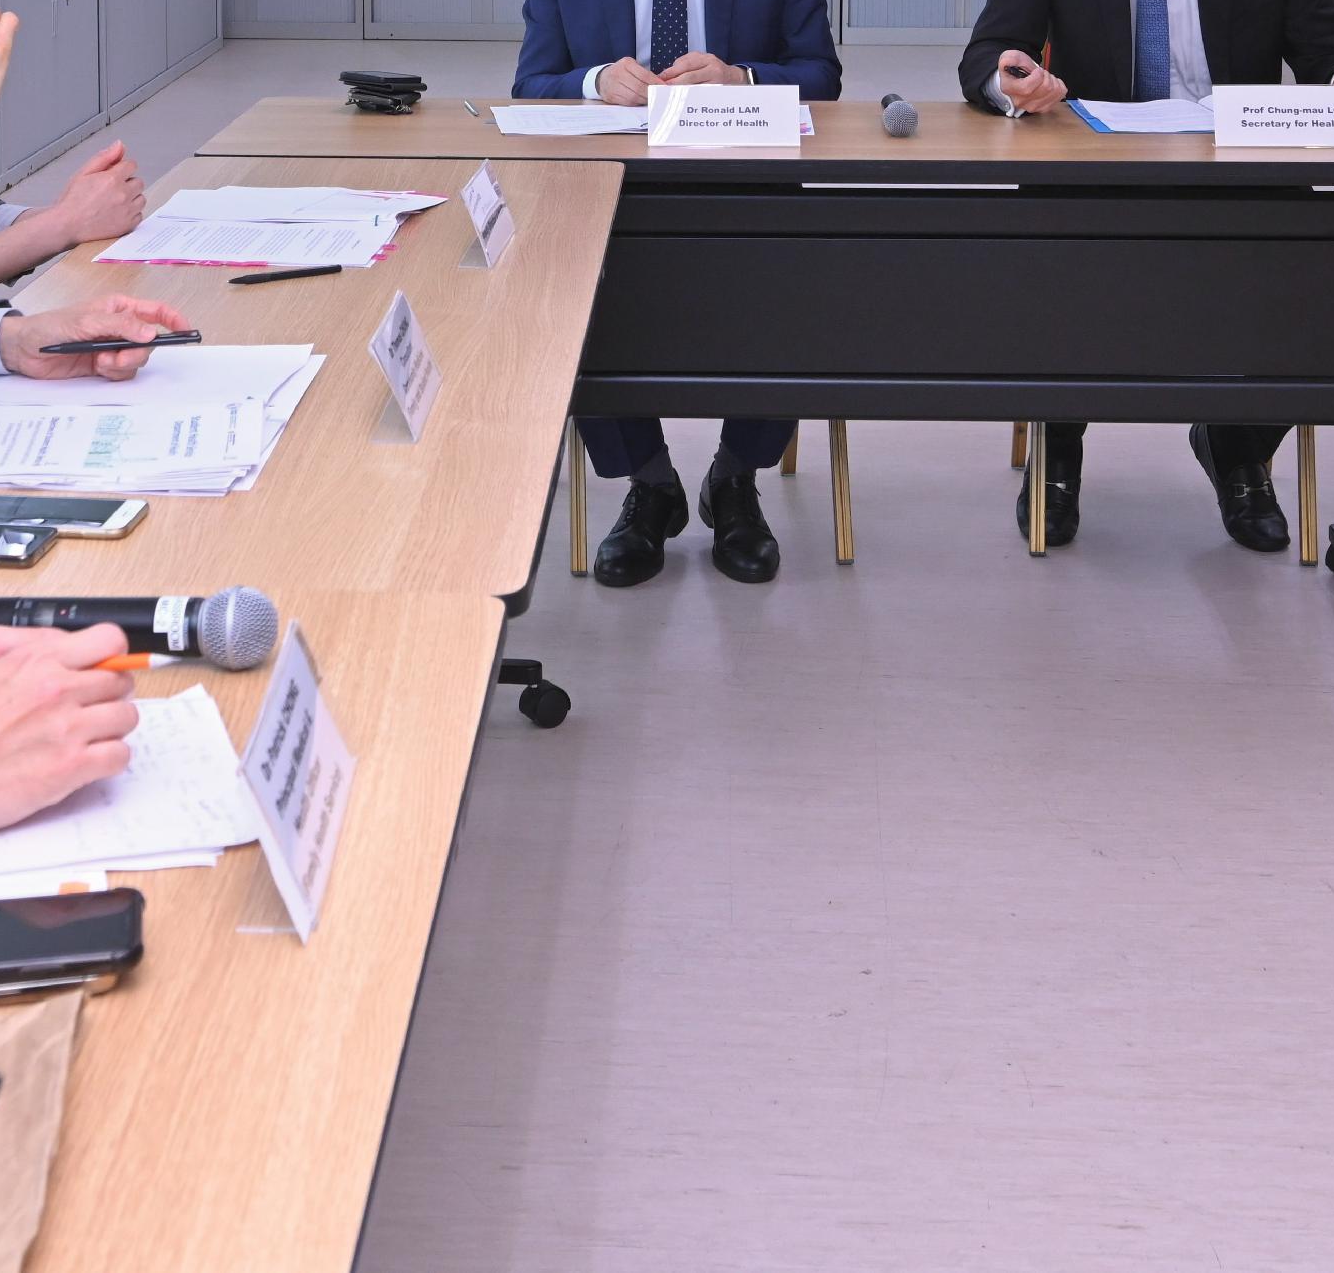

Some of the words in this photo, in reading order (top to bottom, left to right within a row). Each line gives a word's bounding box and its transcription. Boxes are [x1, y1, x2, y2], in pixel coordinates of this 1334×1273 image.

[701, 106, 735, 114] Ronald
[1243, 106, 1265, 114] Prof
[1267, 106, 1324, 115] Chung-mau
[679, 119, 720, 127] Director
[723, 119, 733, 127] of
[736, 119, 769, 127] Health
[1241, 119, 1291, 129] Secretary
